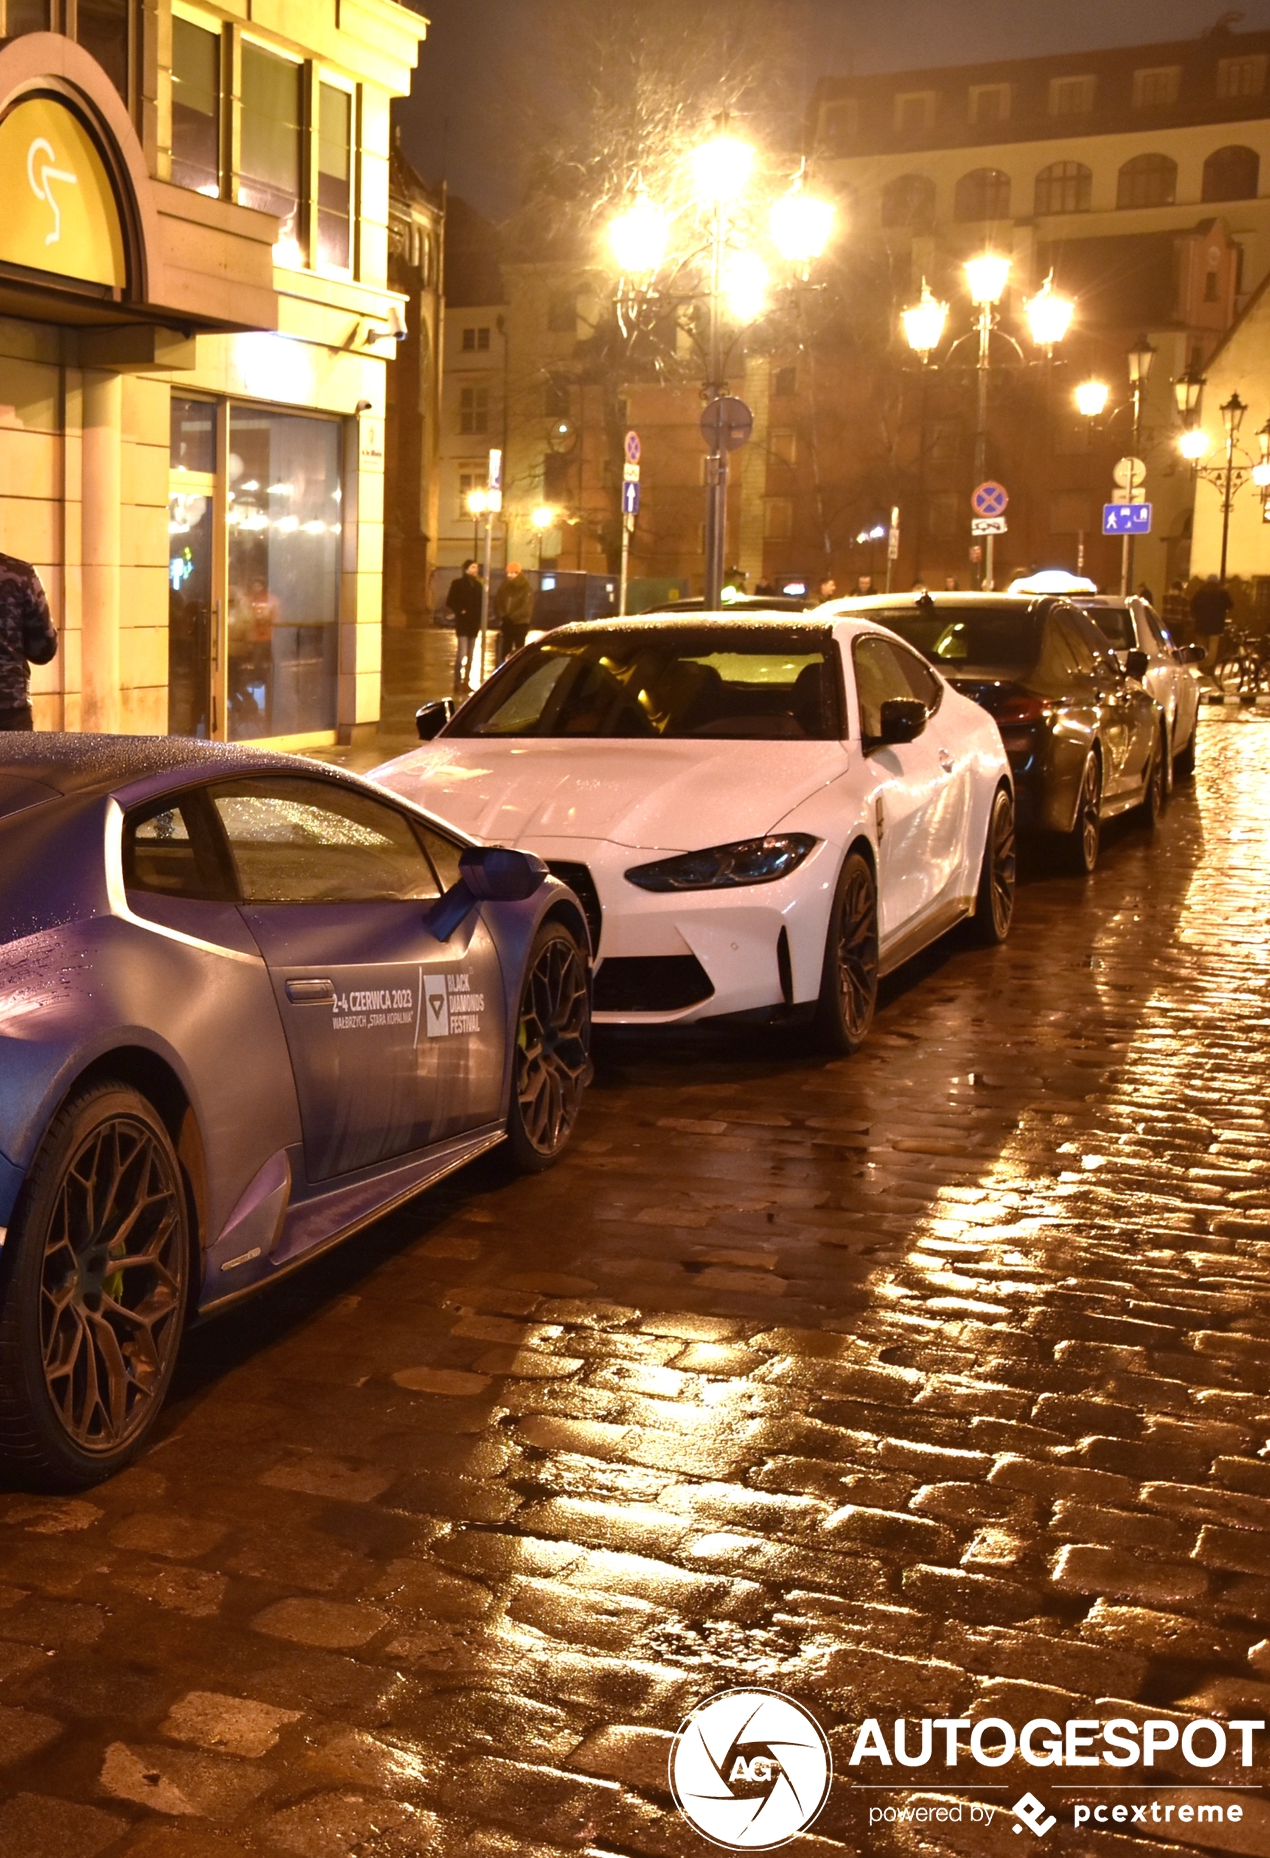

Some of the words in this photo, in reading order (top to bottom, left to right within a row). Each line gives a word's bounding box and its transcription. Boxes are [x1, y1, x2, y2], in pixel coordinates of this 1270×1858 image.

[447, 973, 470, 992] BLACK
[332, 993, 348, 1013] 2-4
[349, 990, 392, 1011] CZERWCA
[392, 989, 413, 1009] 2023
[449, 993, 485, 1013] DIAMONDS
[332, 1015, 367, 1030] WAŁBRZYCH
[450, 1014, 480, 1034] FESTIVAL
